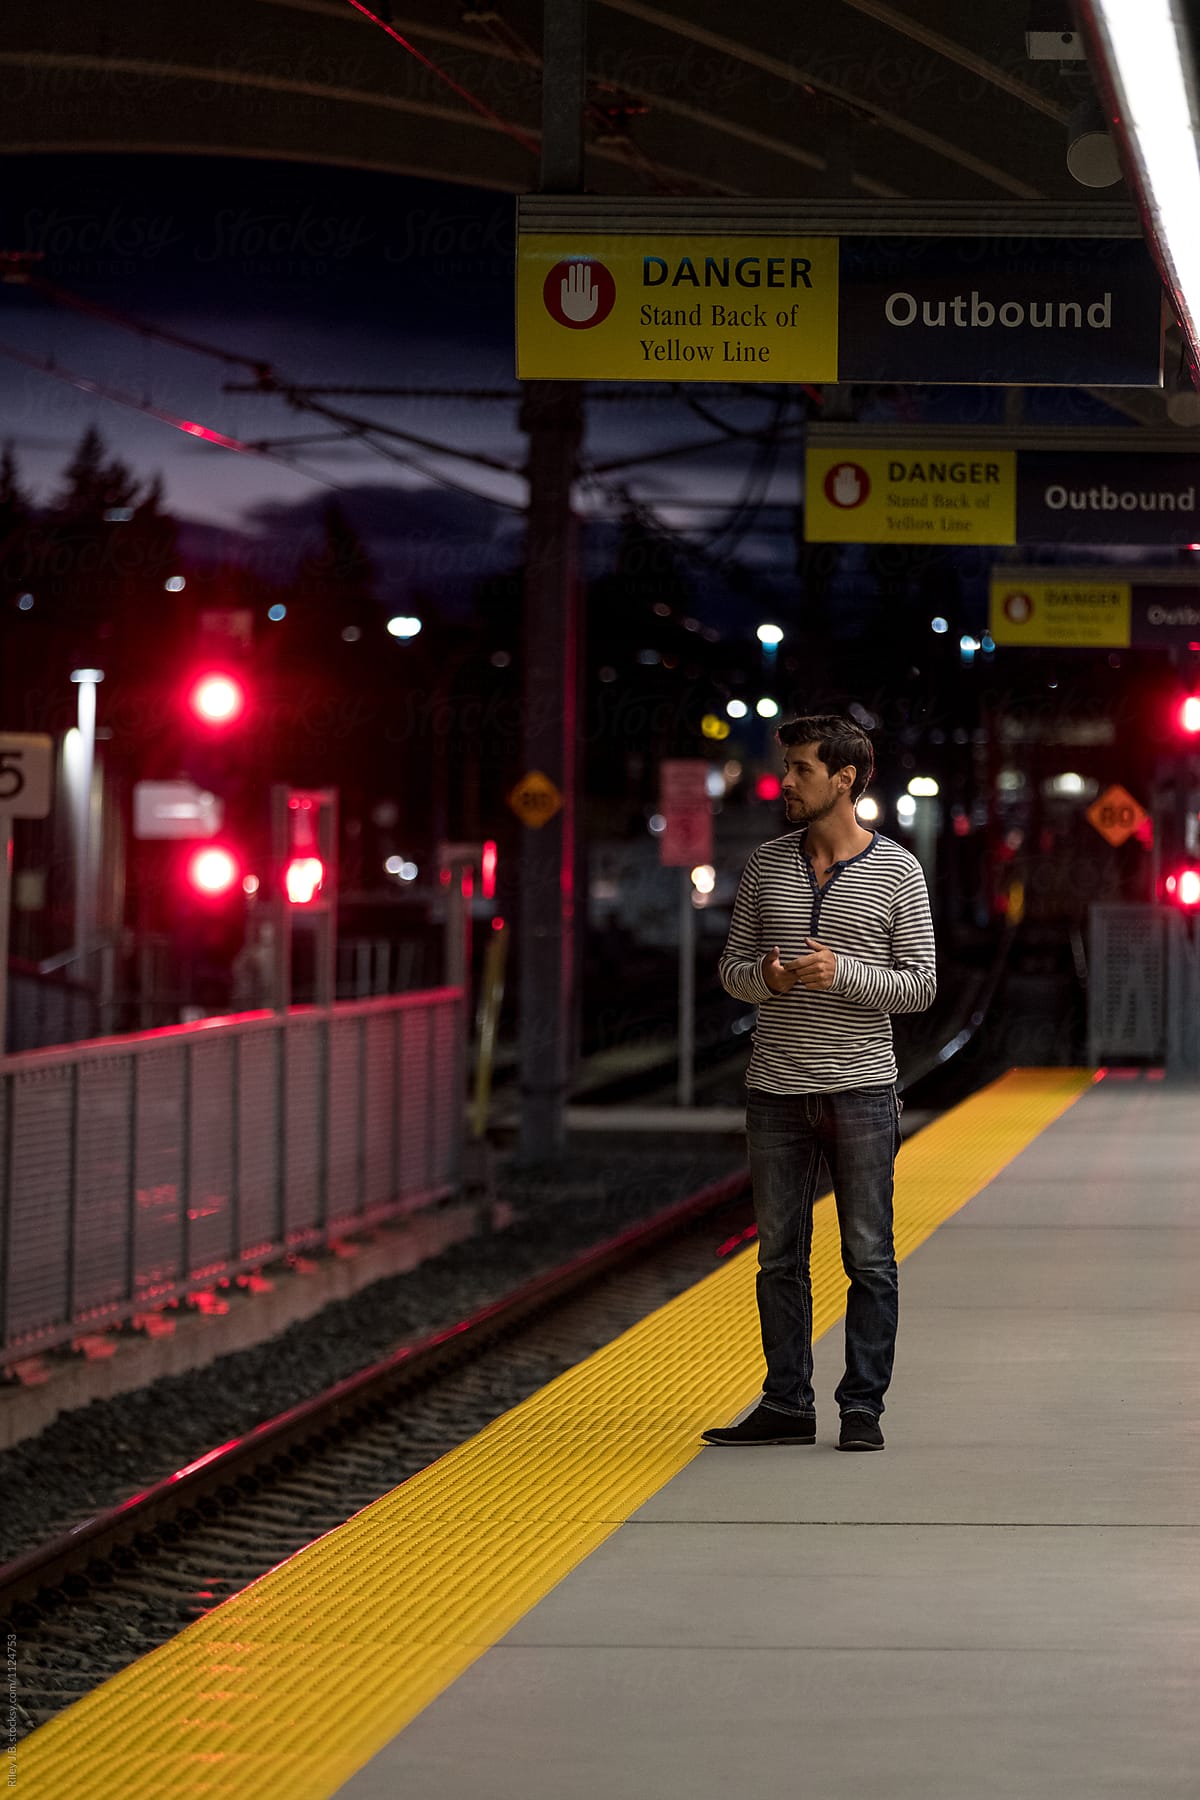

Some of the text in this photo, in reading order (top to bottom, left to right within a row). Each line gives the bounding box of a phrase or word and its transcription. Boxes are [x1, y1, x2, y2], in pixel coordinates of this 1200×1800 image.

[642, 255, 813, 289] DANGER
[639, 304, 800, 328] Stand Back of
[884, 291, 1113, 328] Outbound
[639, 340, 770, 363] Yellow Line
[888, 462, 1000, 484] DANGER
[886, 493, 990, 510] Stand Back of
[1044, 486, 1196, 512] Outbound
[886, 516, 973, 532] Yellow Line
